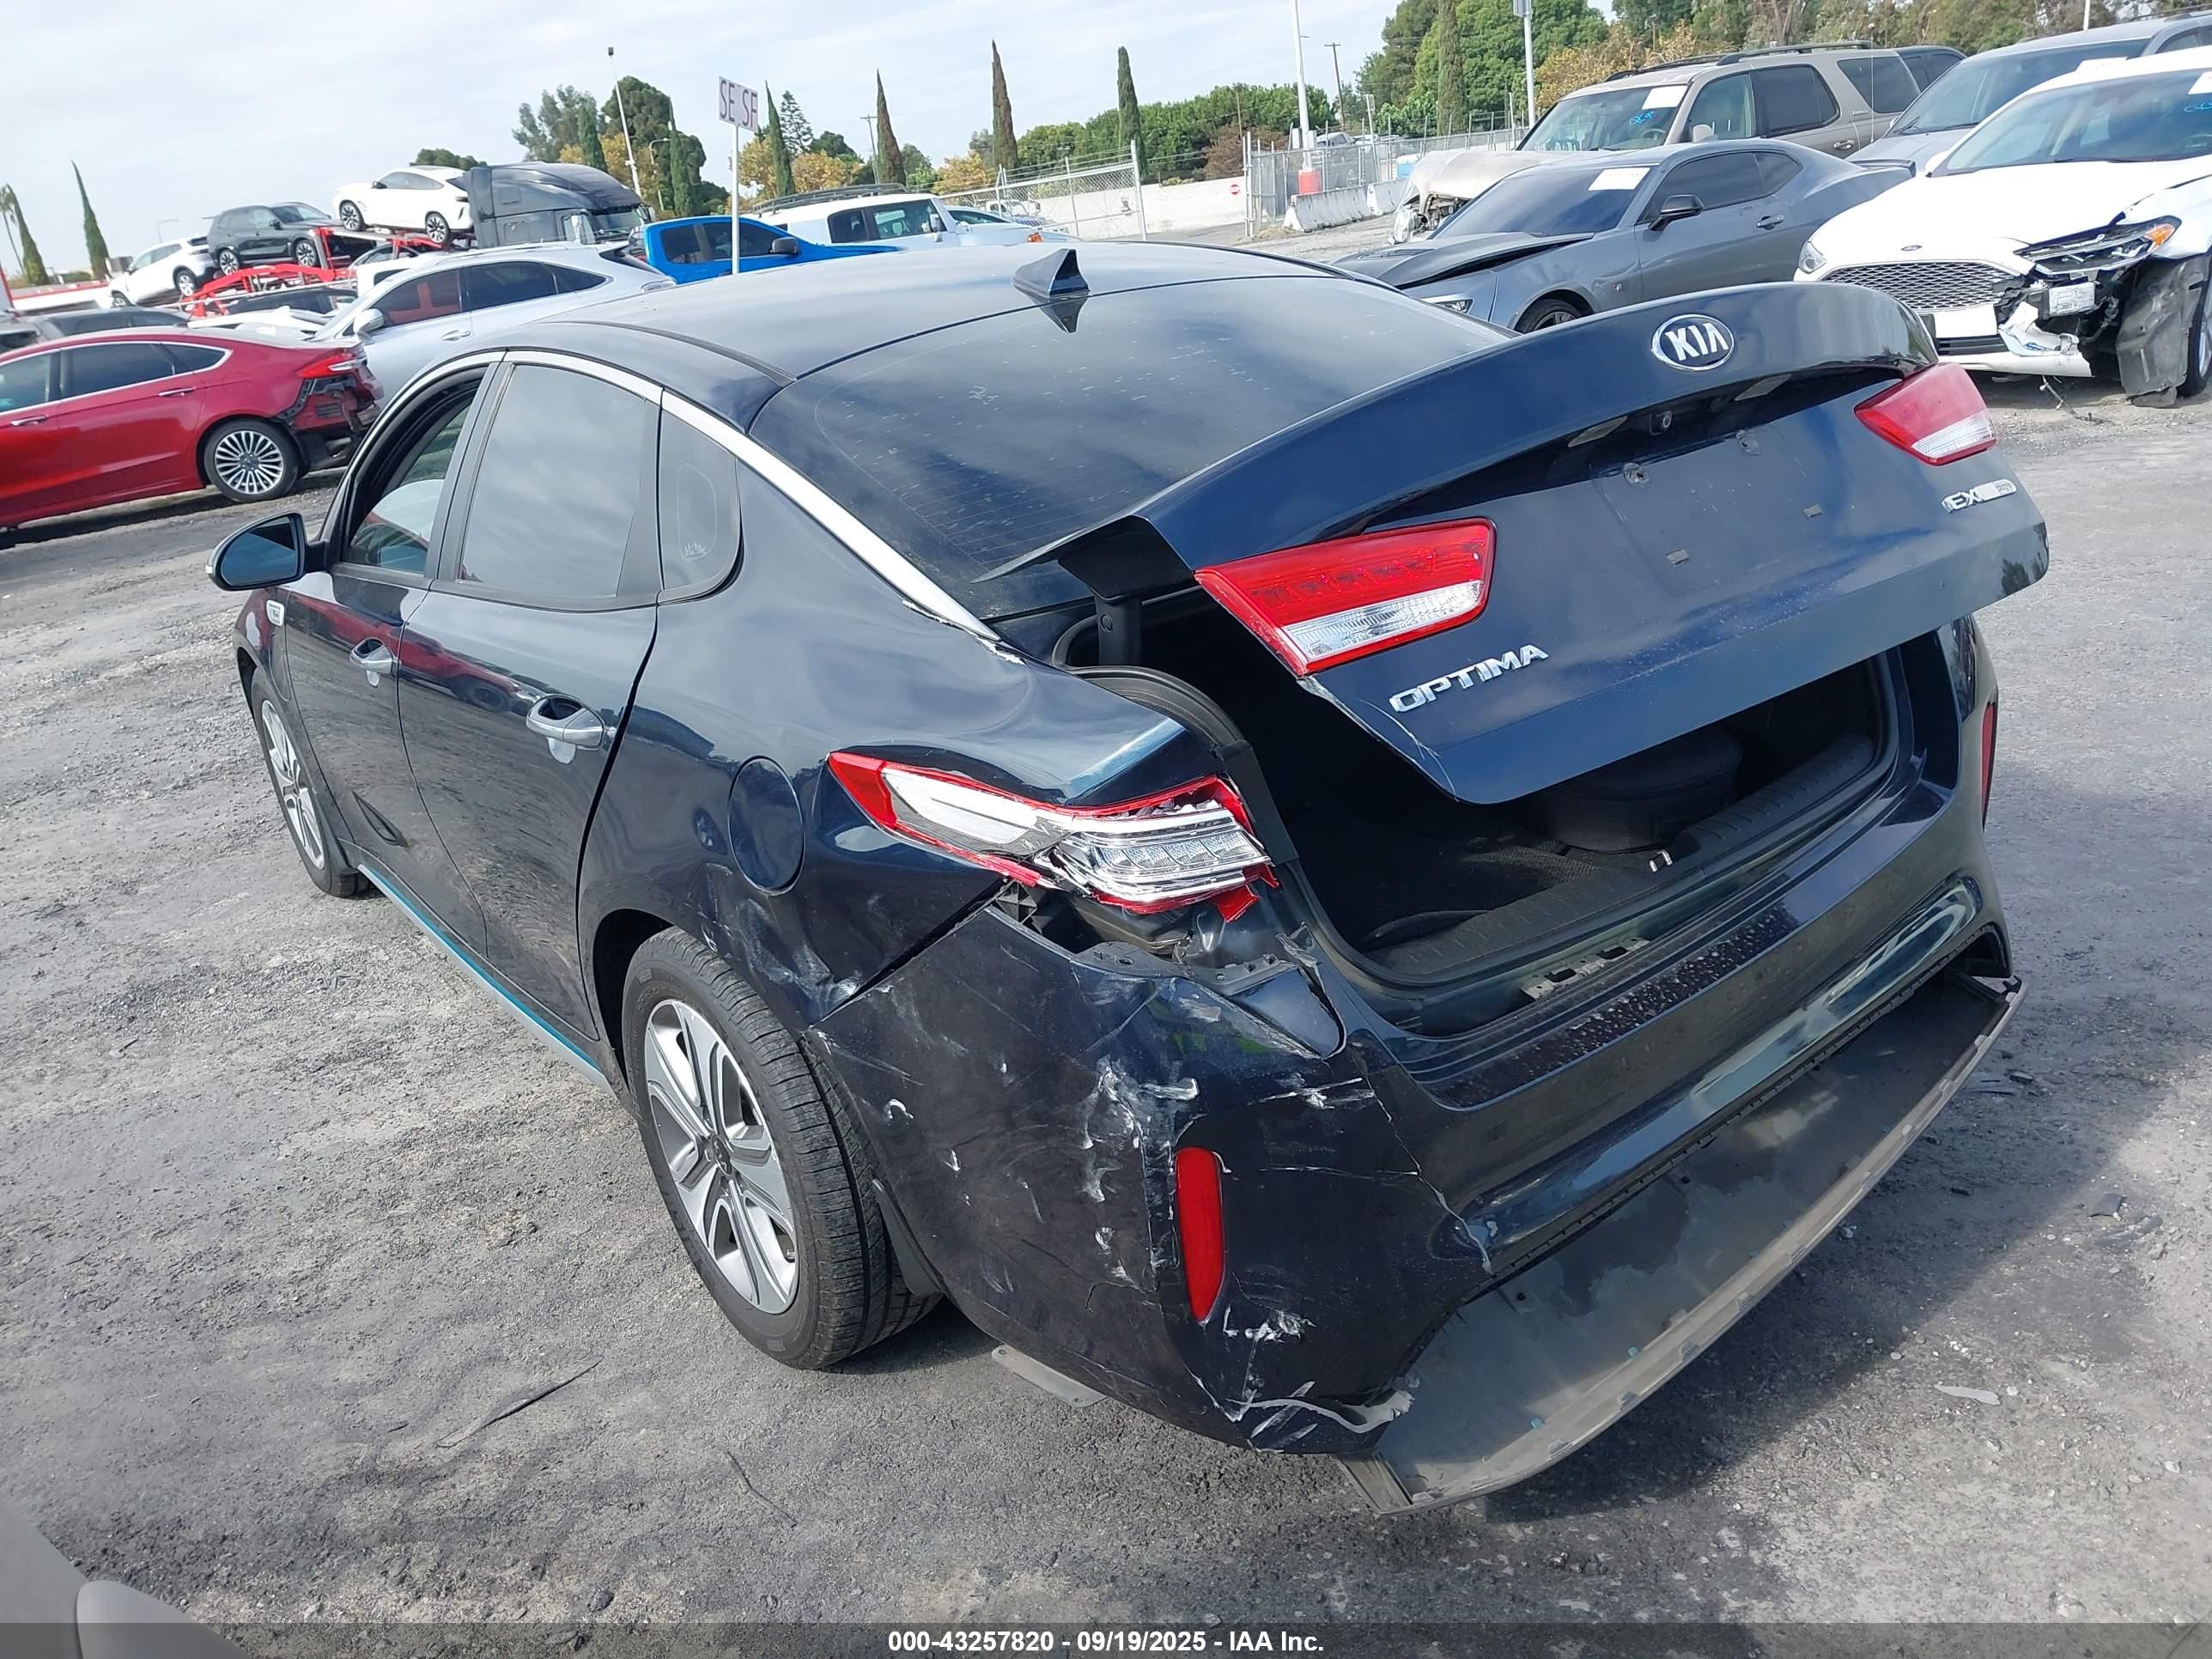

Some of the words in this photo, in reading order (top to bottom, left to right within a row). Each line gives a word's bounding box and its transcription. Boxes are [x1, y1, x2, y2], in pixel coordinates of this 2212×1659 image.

[720, 79, 736, 123] SE
[1664, 322, 1729, 361] KIA
[1943, 489, 1983, 513] EX
[1389, 644, 1549, 713] OPTIMA
